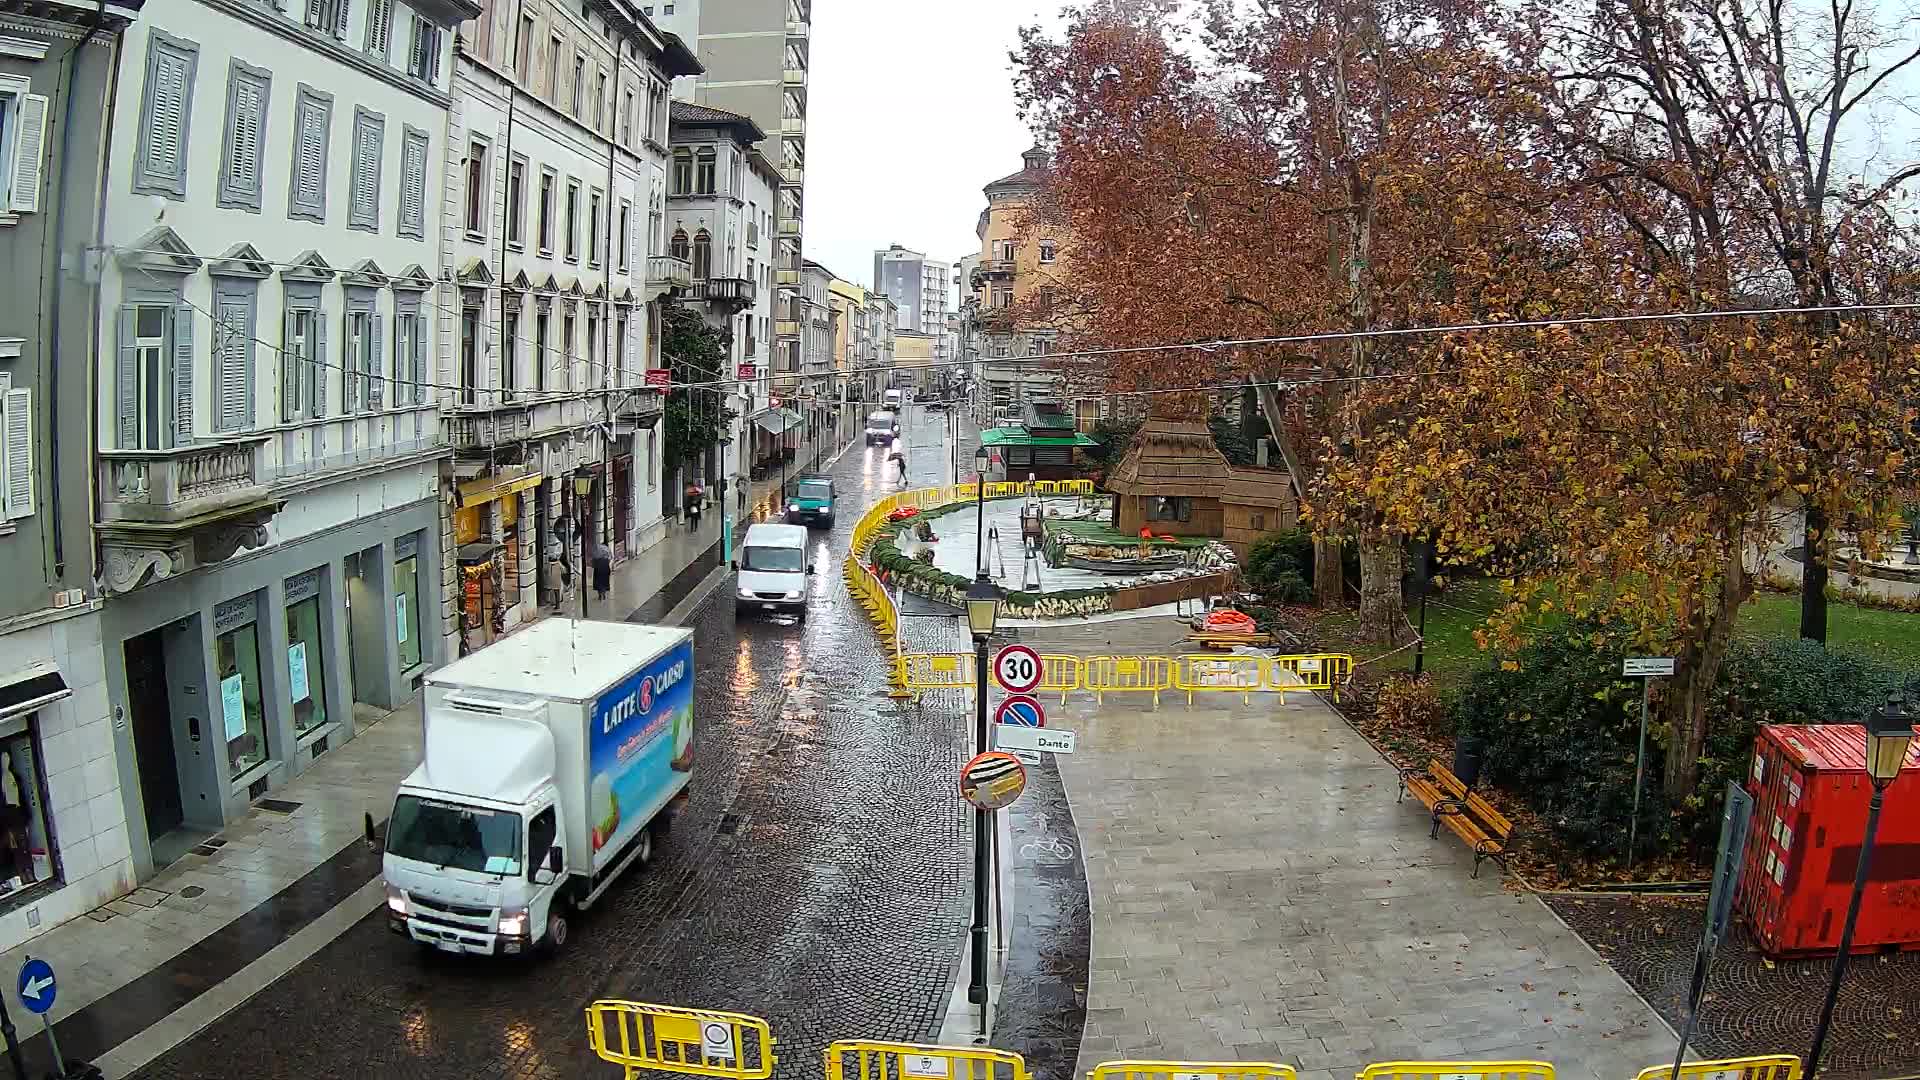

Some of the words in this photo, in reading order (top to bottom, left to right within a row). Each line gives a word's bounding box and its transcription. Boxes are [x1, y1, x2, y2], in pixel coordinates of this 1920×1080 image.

[1005, 658, 1033, 680] 30
[604, 690, 636, 733] LATTE
[656, 660, 684, 694] CARSO
[1038, 737, 1069, 749] Dante
